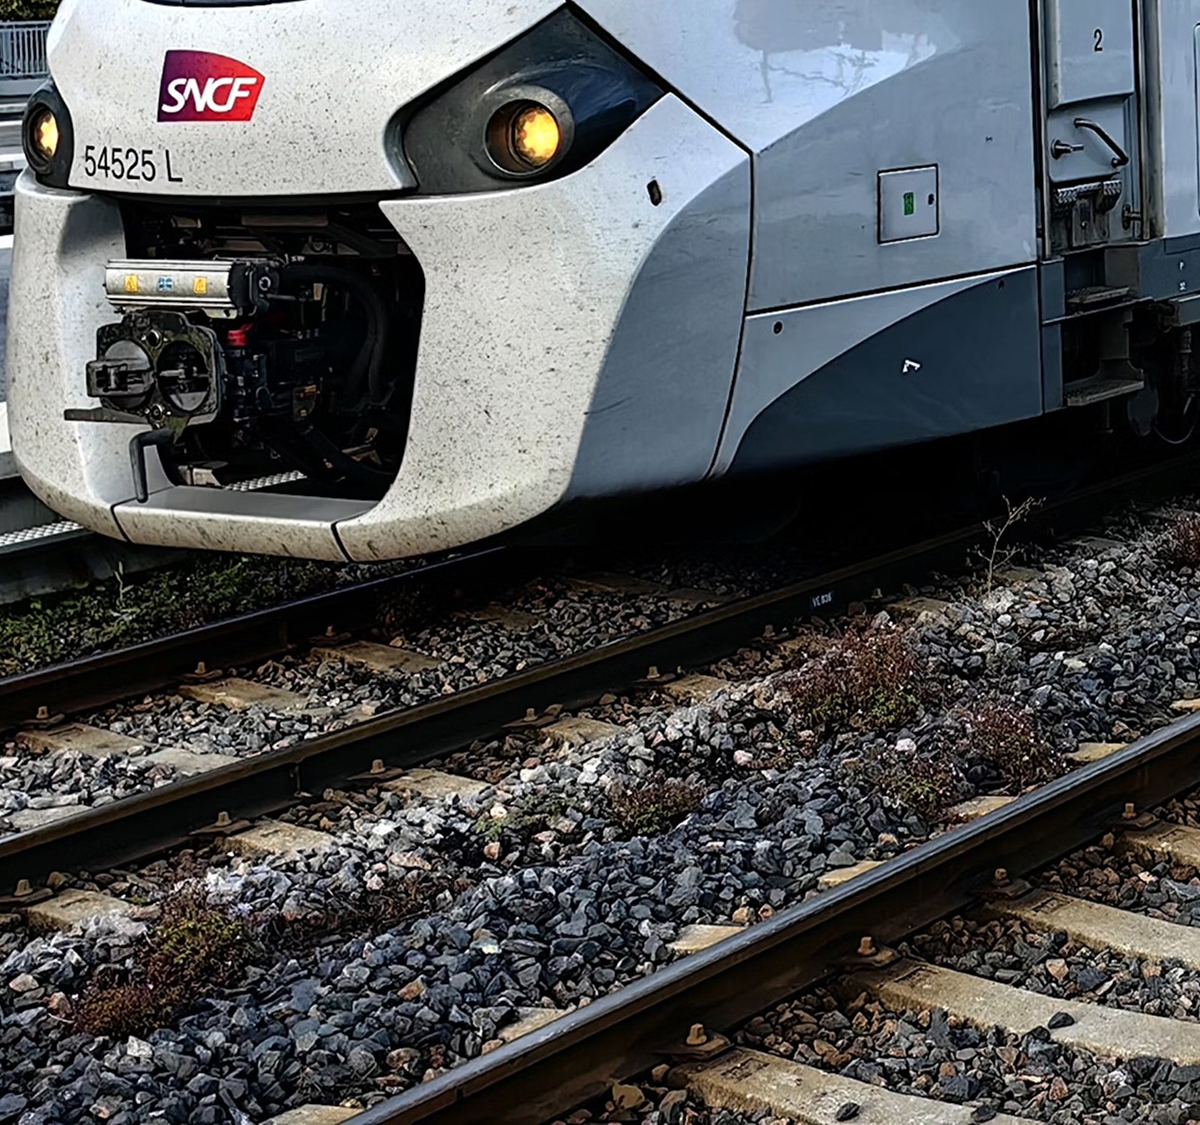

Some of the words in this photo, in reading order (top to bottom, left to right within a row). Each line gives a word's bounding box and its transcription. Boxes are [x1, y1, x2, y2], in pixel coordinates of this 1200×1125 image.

[1093, 28, 1103, 52] 2
[161, 77, 257, 113] SNCF
[84, 145, 156, 181] 54525
[165, 149, 183, 182] L
